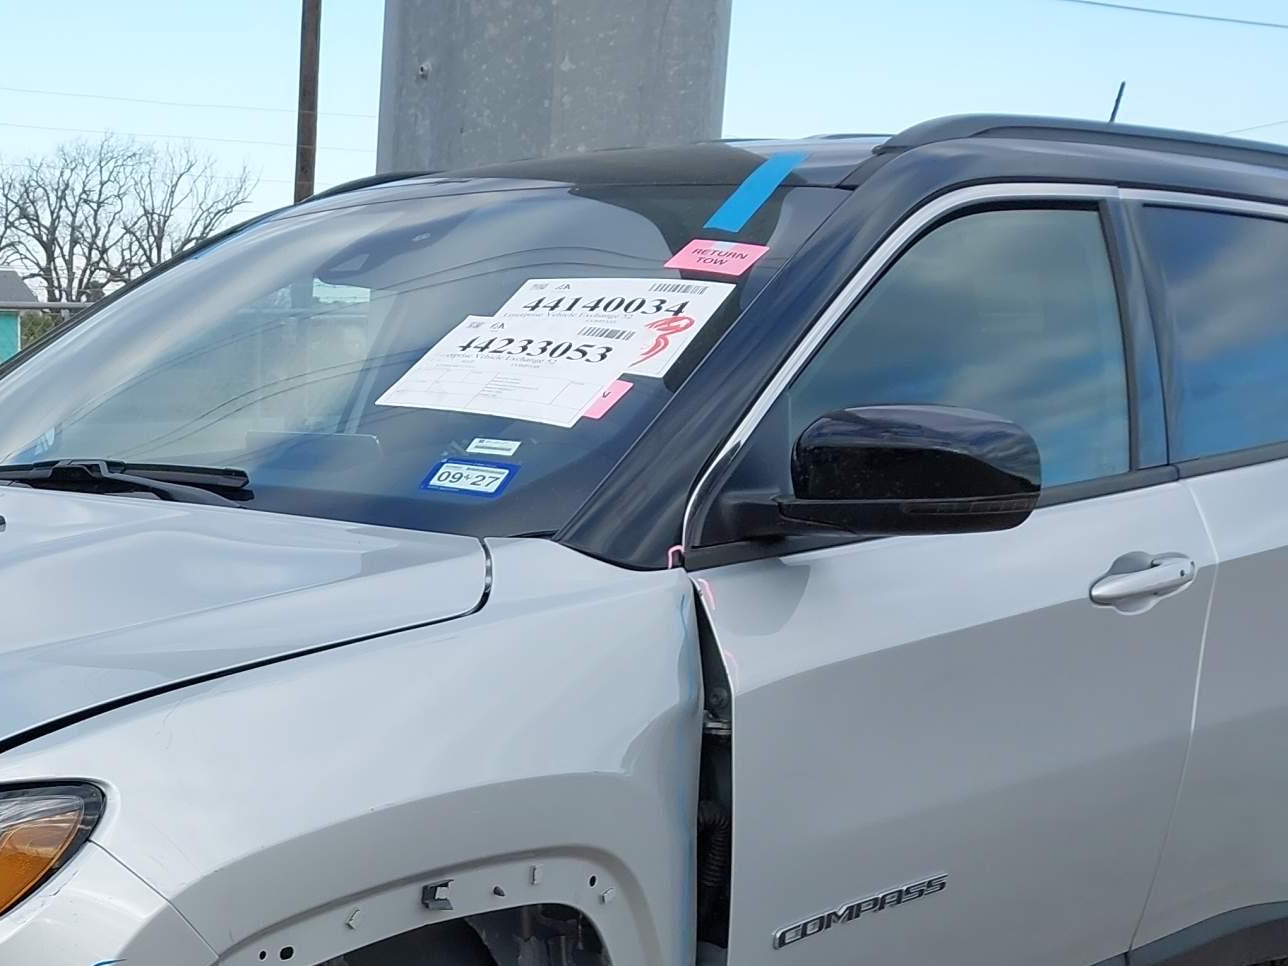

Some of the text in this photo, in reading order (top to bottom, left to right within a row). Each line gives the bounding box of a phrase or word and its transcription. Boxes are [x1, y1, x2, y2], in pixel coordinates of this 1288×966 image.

[691, 248, 749, 260] RETURN
[696, 256, 728, 266] TOW
[522, 296, 690, 317] 44140034
[458, 335, 614, 364] 44233053
[772, 872, 950, 950] COMPASS
